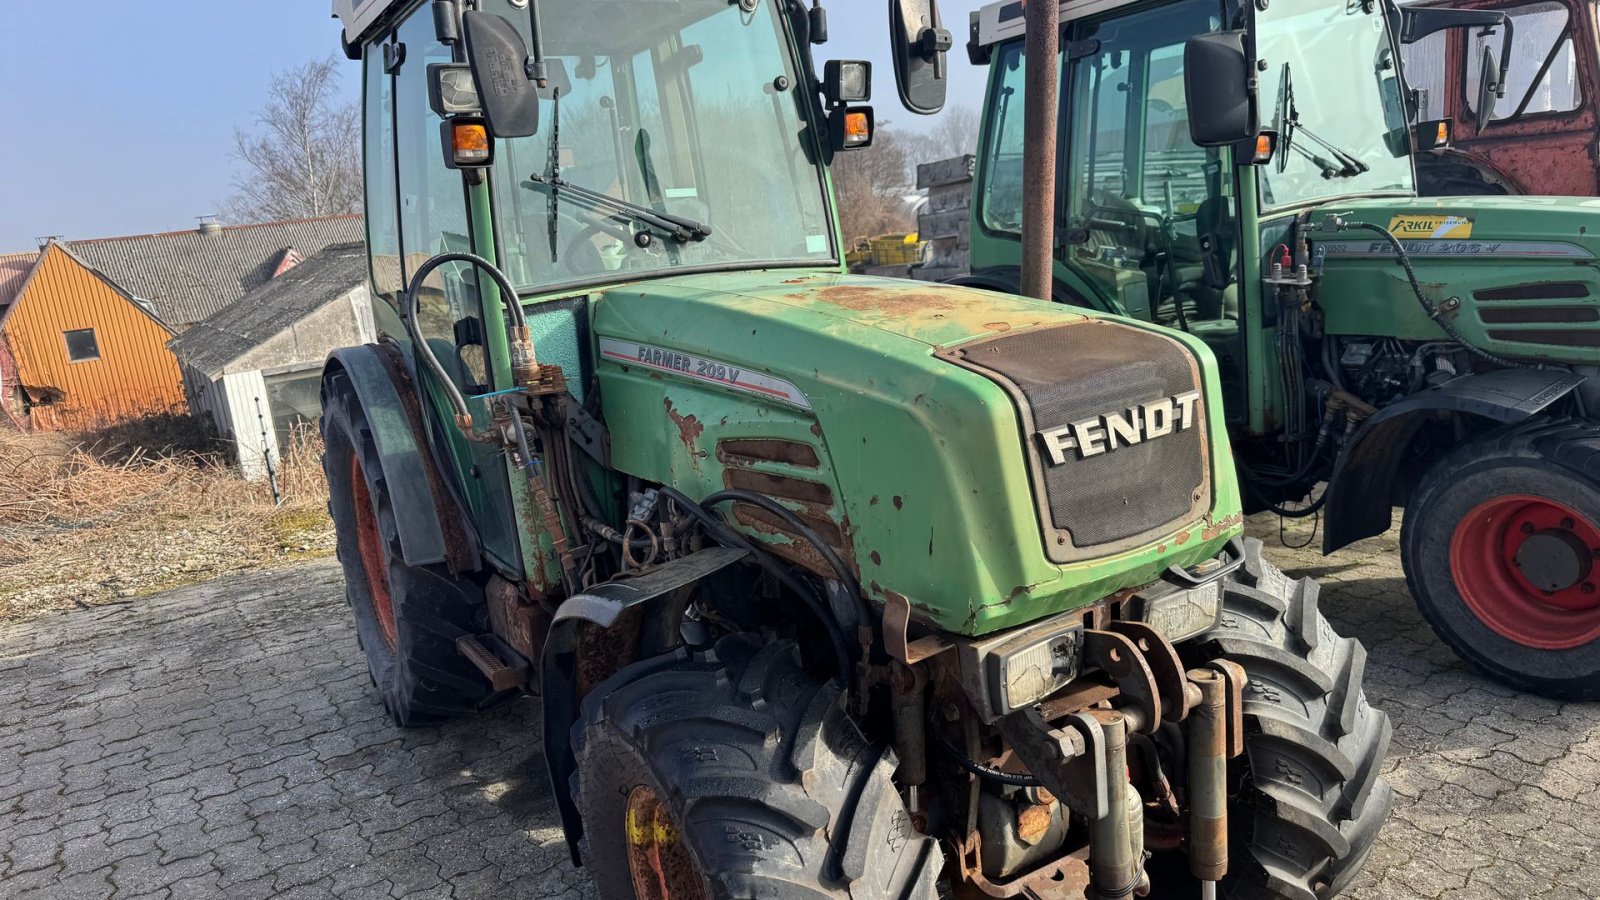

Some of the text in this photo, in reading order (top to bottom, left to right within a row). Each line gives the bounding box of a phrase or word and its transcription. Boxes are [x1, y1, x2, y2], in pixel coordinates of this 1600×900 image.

[1391, 220, 1434, 232] ARKIL
[1485, 243, 1501, 254] V
[638, 347, 740, 383] FARMER 209 V
[1037, 390, 1200, 465] FENDT
